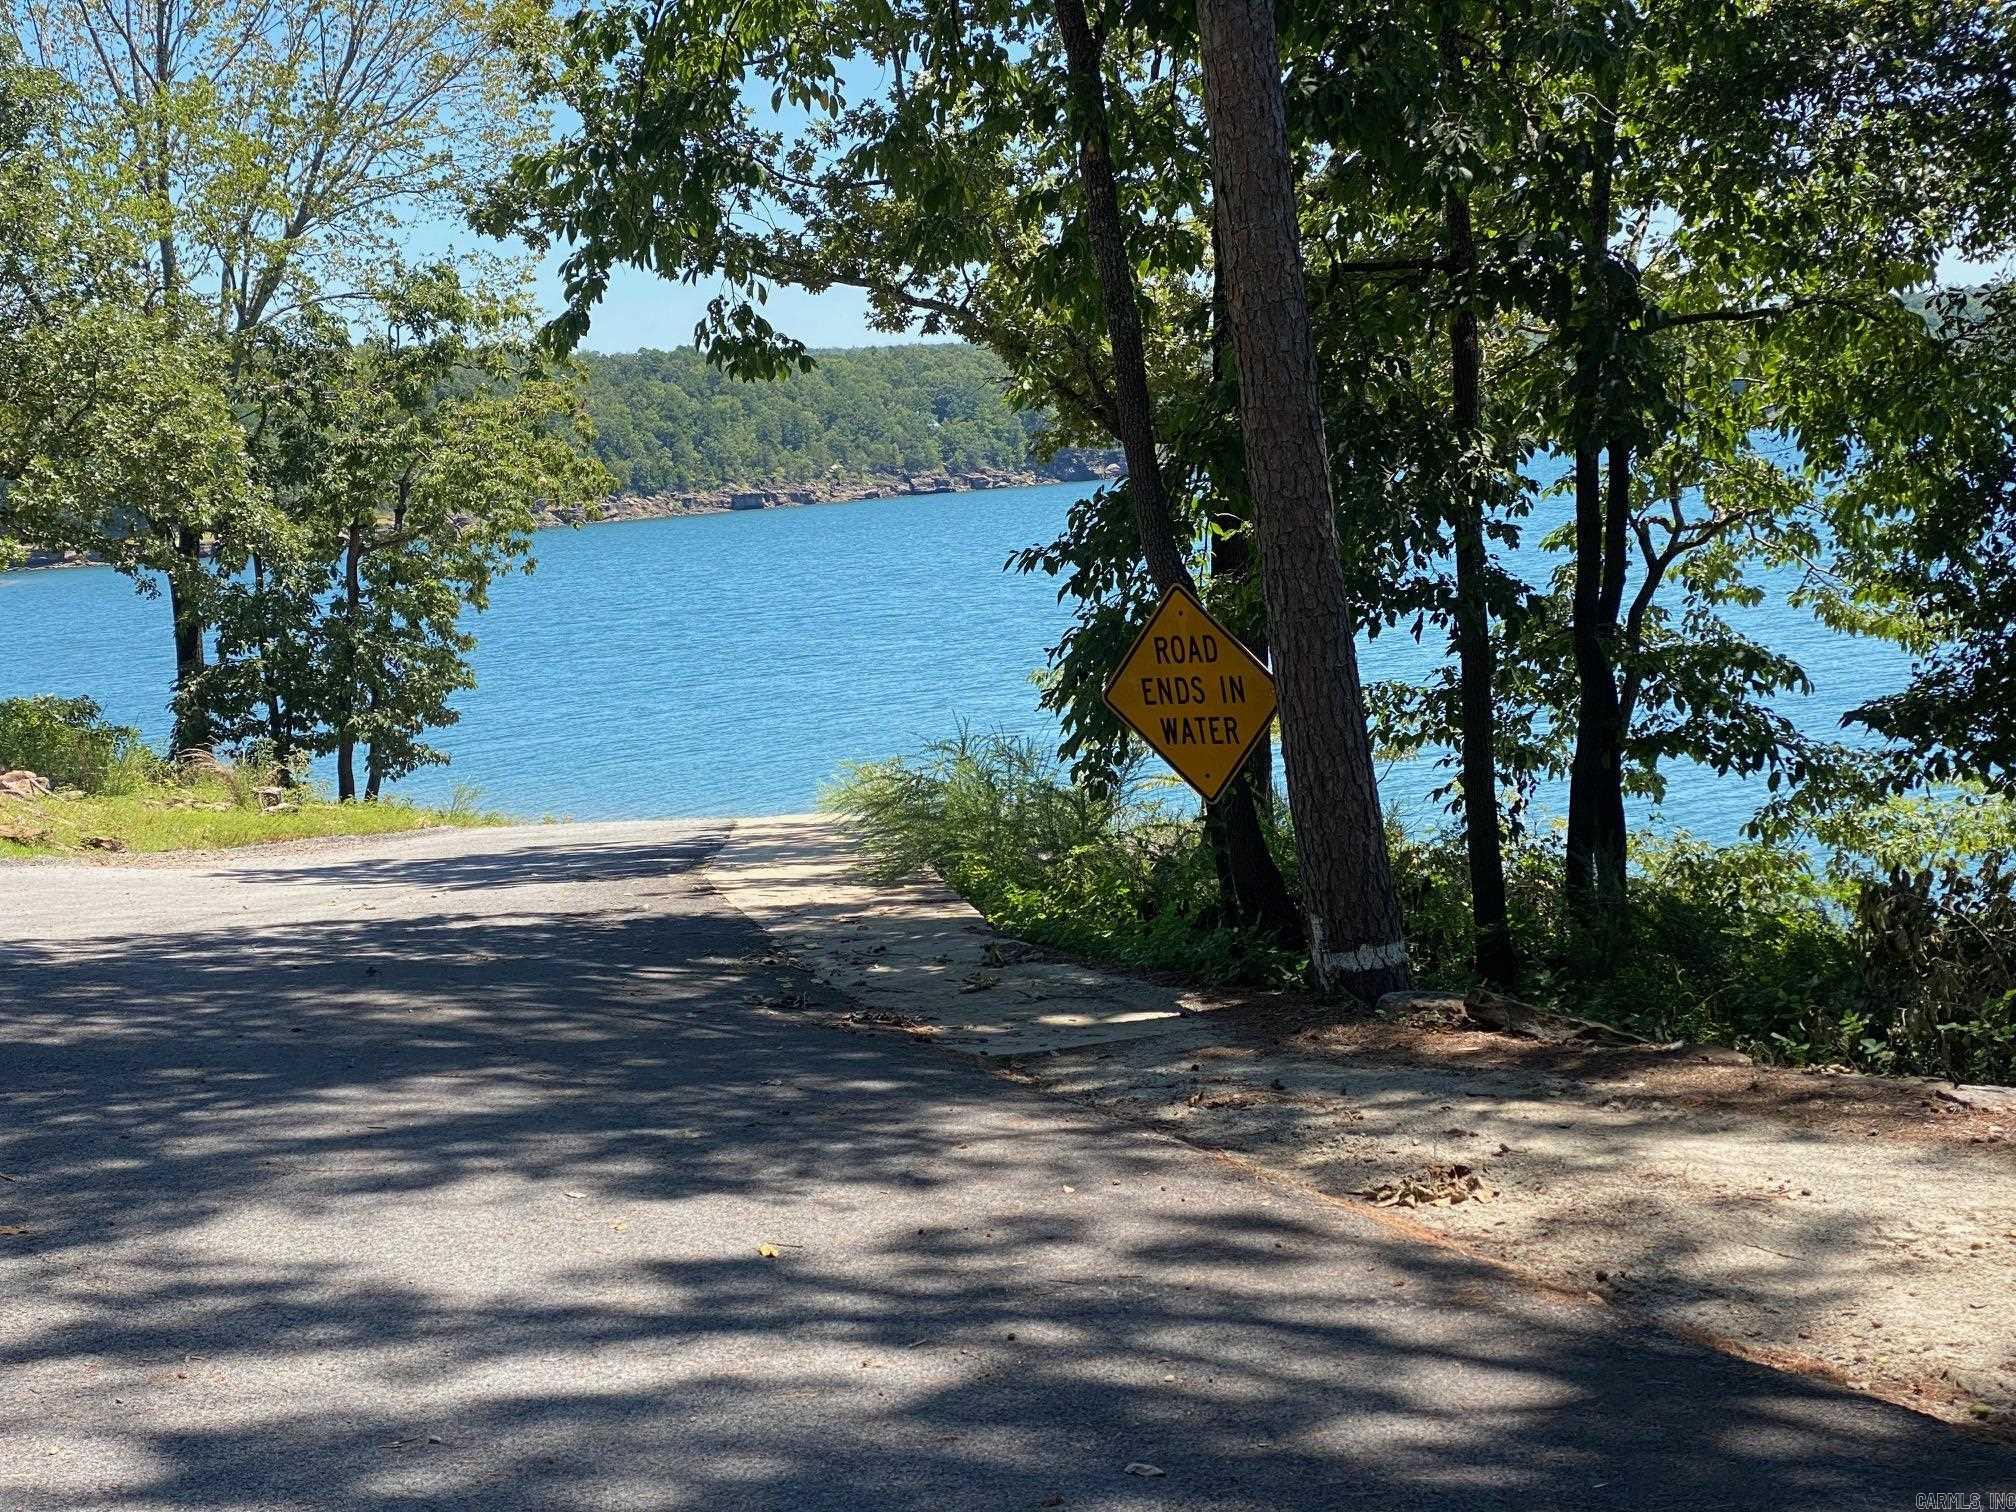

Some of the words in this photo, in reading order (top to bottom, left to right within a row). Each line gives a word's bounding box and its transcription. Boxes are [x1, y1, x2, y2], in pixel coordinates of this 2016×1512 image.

[1153, 635, 1218, 664] ROAD
[1141, 676, 1206, 705] ENDS
[1219, 675, 1247, 704] IN
[1160, 716, 1241, 745] WATER
